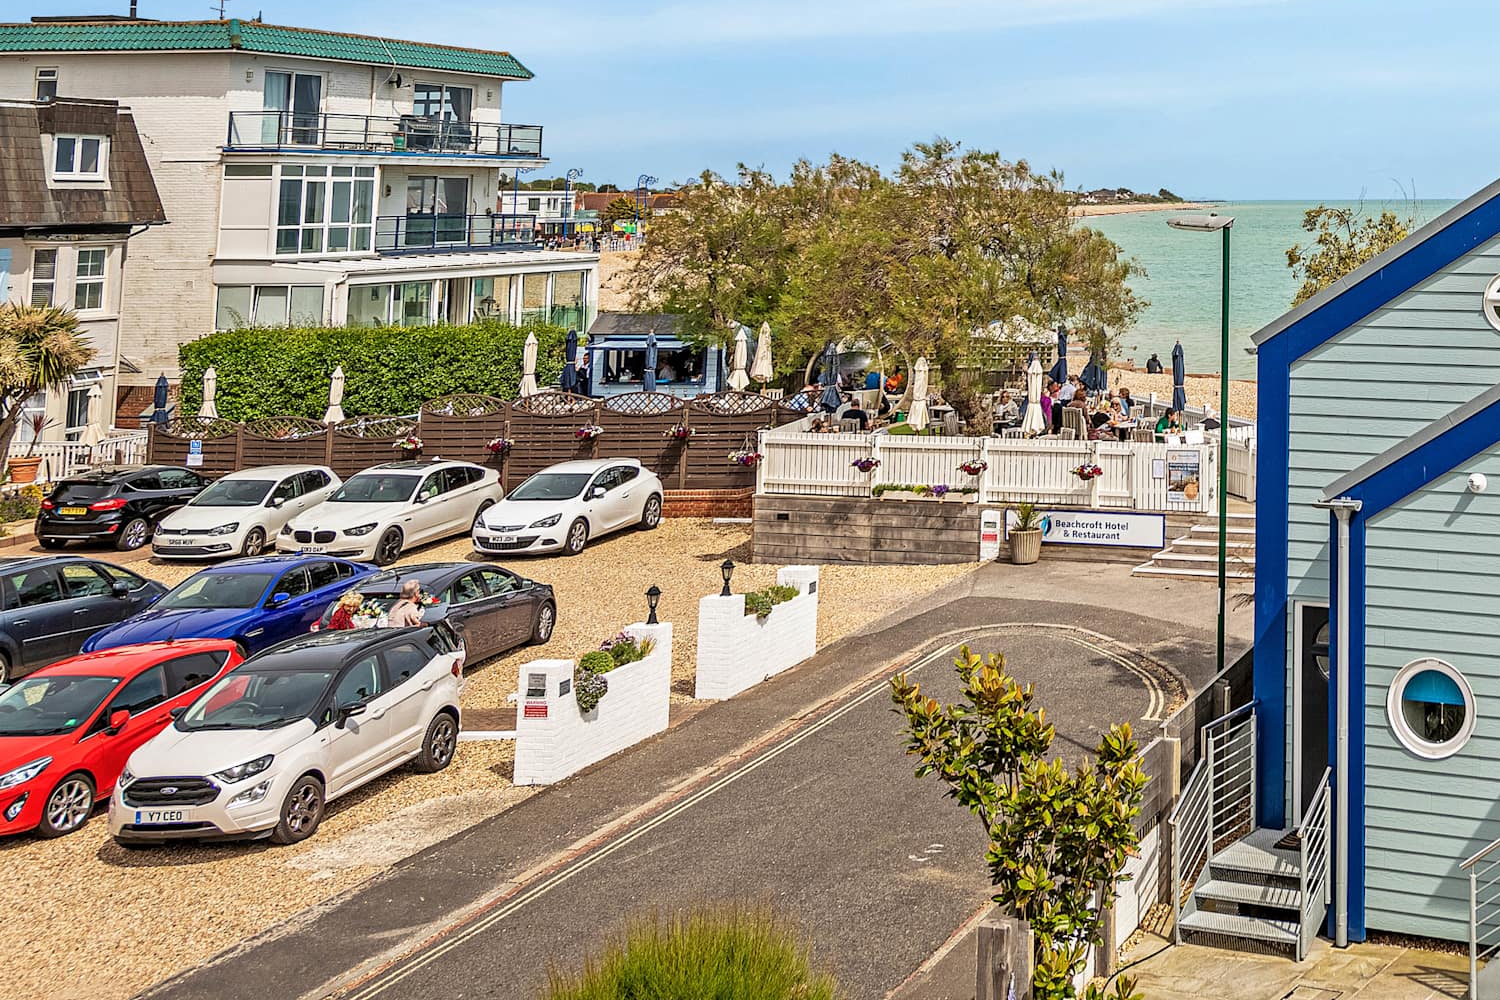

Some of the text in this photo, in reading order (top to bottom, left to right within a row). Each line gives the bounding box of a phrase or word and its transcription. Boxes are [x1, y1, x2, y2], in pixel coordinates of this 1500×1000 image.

[1055, 519, 1129, 531] Beachcroft Hotel
[1063, 529, 1120, 540] & Restaurant
[148, 811, 183, 821] Y7 CEO
